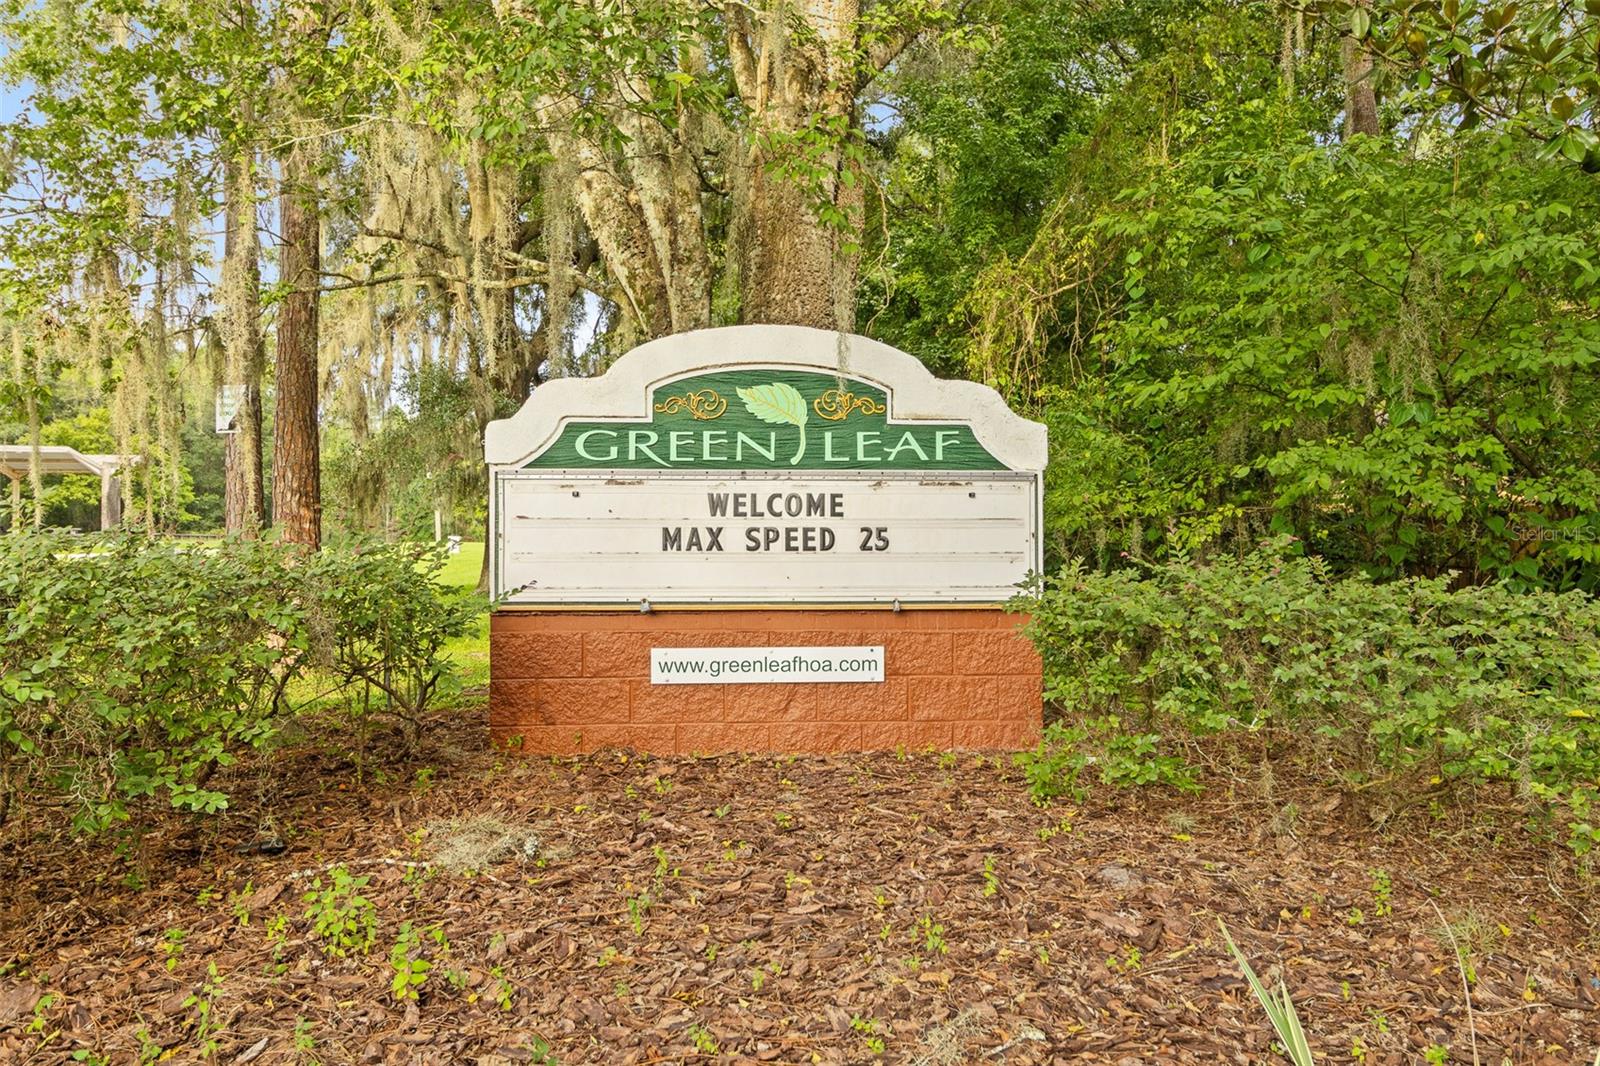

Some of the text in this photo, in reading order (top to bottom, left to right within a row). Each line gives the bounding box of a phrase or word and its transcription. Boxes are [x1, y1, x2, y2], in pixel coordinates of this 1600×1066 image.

[575, 430, 960, 467] GREEN LEAF
[707, 492, 844, 518] WELCOME
[661, 527, 890, 552] MAX SPEED 25
[658, 656, 878, 677] www.greenleafhoa.com
